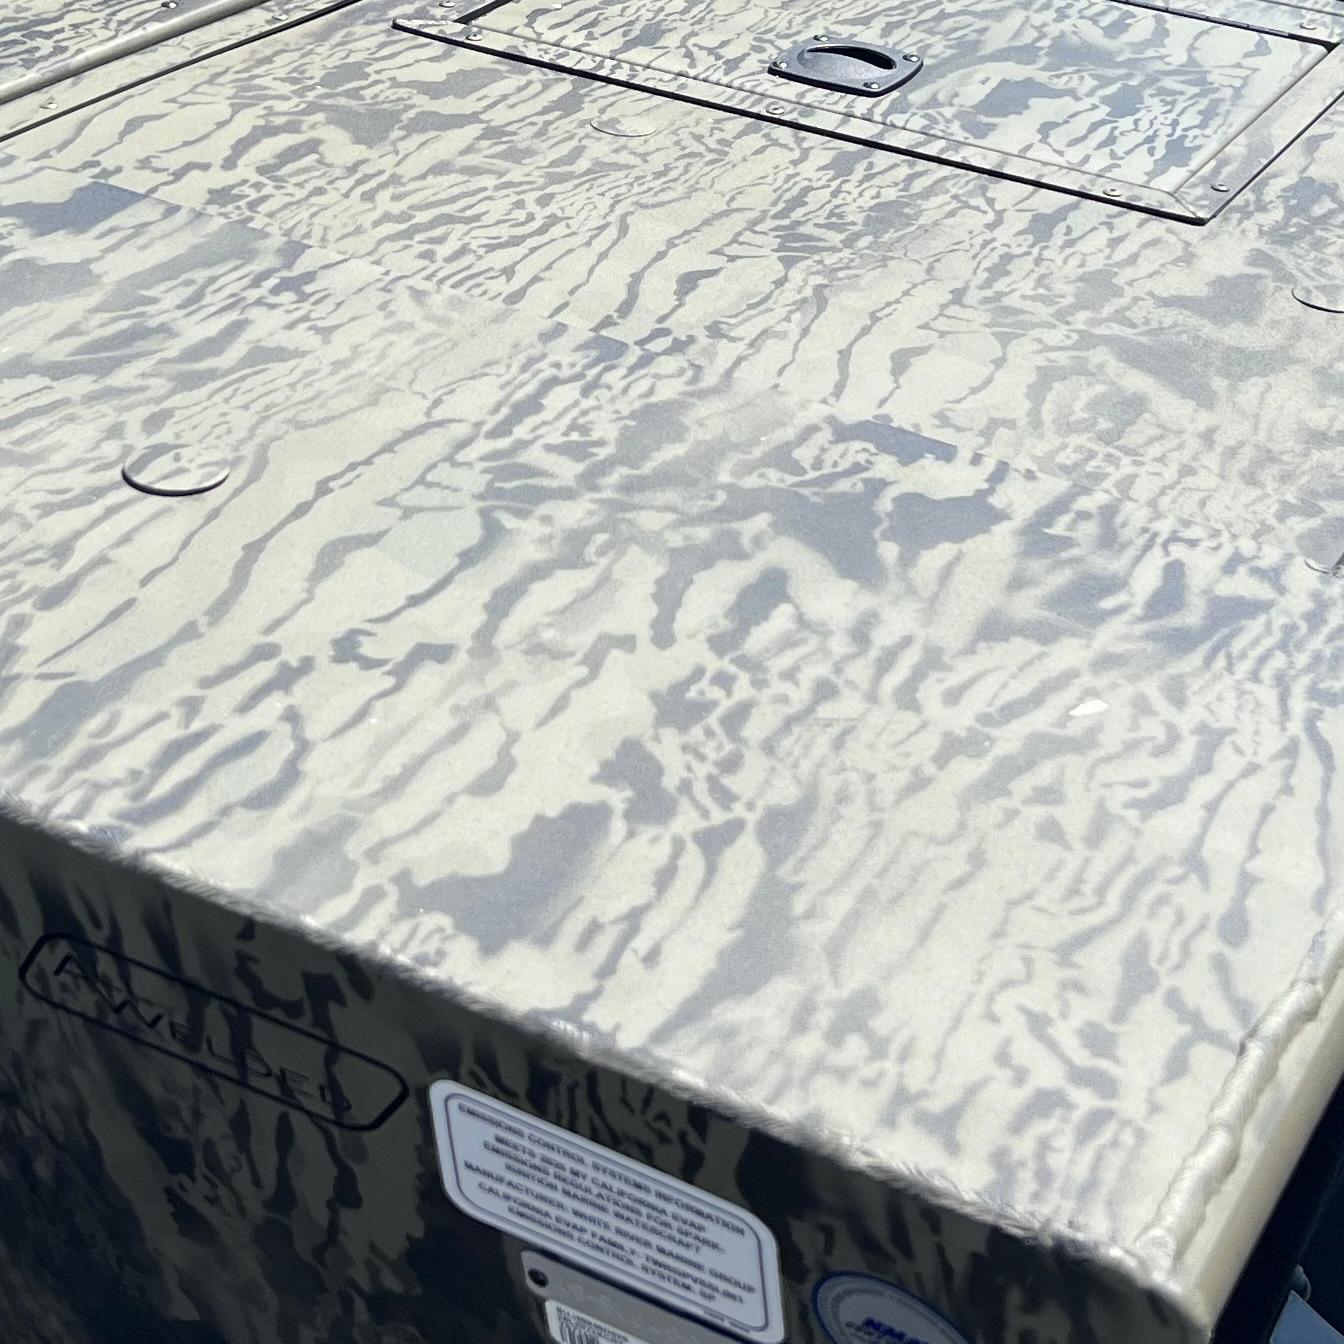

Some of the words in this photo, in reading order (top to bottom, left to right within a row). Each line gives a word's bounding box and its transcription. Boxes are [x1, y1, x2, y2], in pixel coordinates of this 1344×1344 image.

[478, 1181, 551, 1220] CALIFORNIA
[554, 1214, 589, 1237] EVAP
[527, 1132, 585, 1164] CONTROL
[654, 1189, 745, 1236] INFORMATION
[590, 1176, 668, 1217] CALIFORNIA
[671, 1211, 706, 1234] EVAP
[612, 1209, 701, 1255] WATERCRAFT
[645, 1212, 672, 1231] FOR
